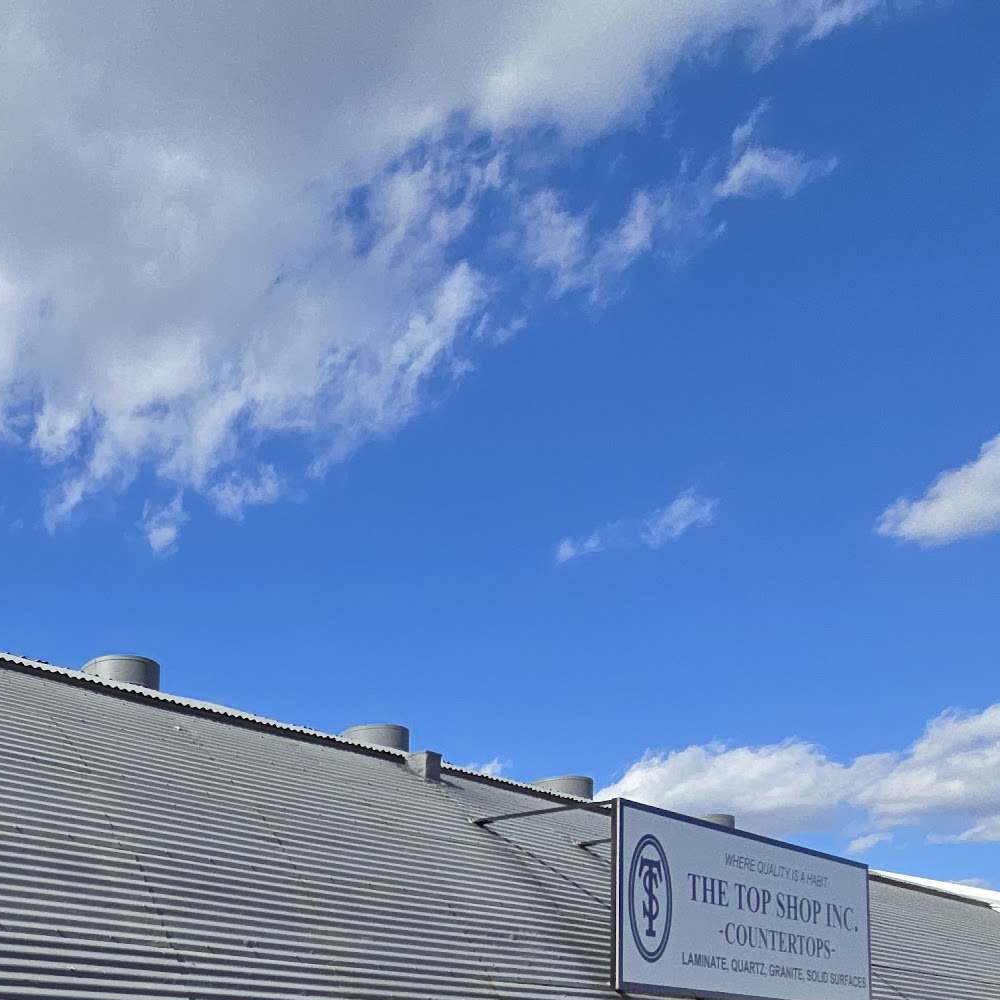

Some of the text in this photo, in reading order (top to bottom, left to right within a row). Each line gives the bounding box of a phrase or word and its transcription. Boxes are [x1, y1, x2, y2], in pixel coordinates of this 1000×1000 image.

[725, 853, 828, 888] WHERE QUALITY IS A HABIT
[687, 873, 858, 932] THE TOP SHOP INC.
[682, 951, 866, 988] LAMINATE, QUARTZ, GRANITE, SOLID SURFACES
